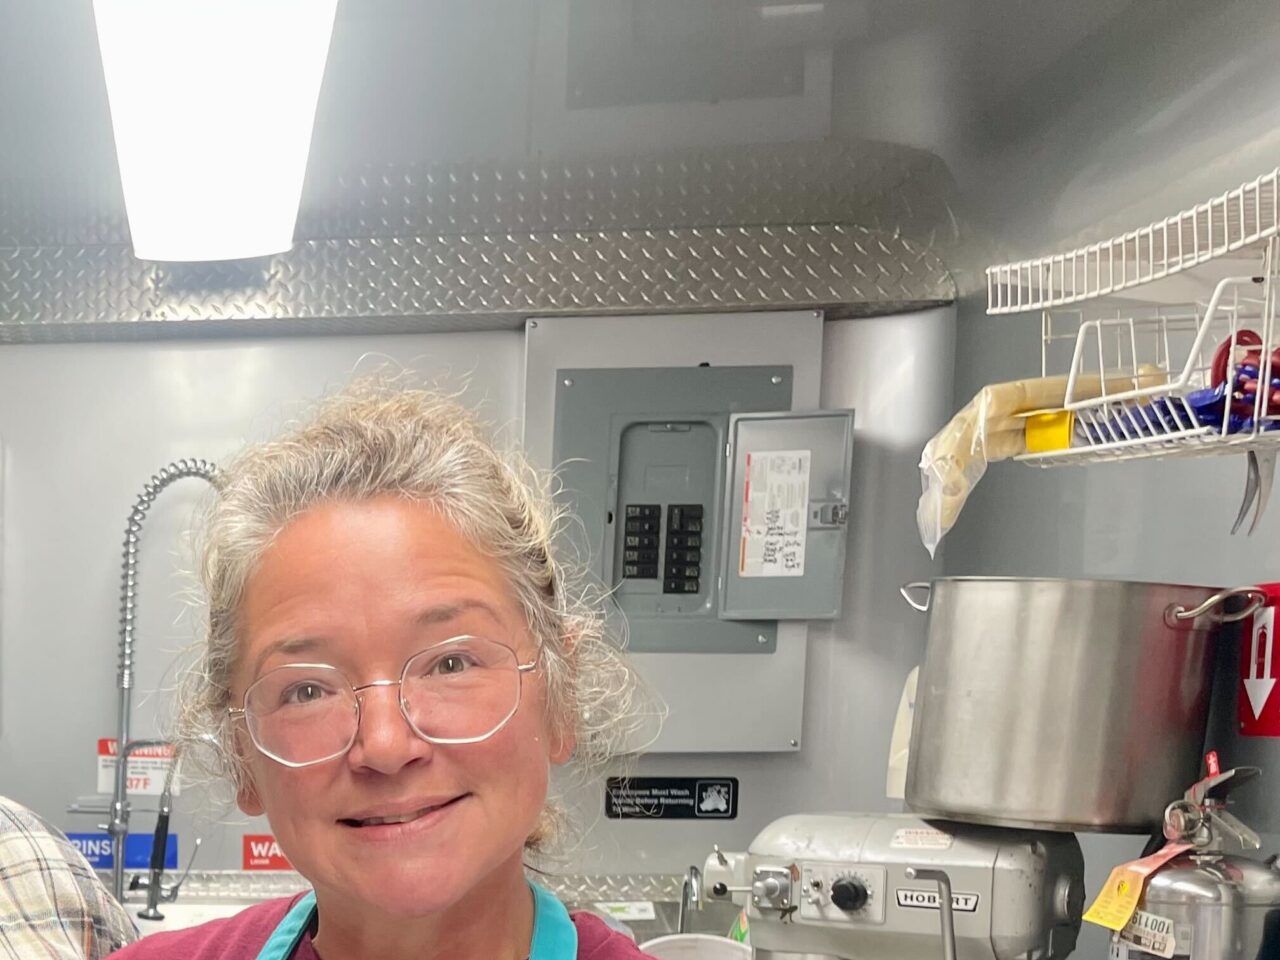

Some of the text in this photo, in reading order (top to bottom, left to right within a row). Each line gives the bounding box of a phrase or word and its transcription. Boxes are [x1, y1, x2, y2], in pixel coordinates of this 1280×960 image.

[107, 740, 172, 757] WNING
[651, 788, 669, 796] Must
[670, 788, 690, 796] Wash
[635, 797, 659, 805] Before
[660, 797, 694, 807] Returning
[71, 839, 115, 856] RINS
[250, 841, 285, 858] WA
[903, 893, 972, 907] HOBRT
